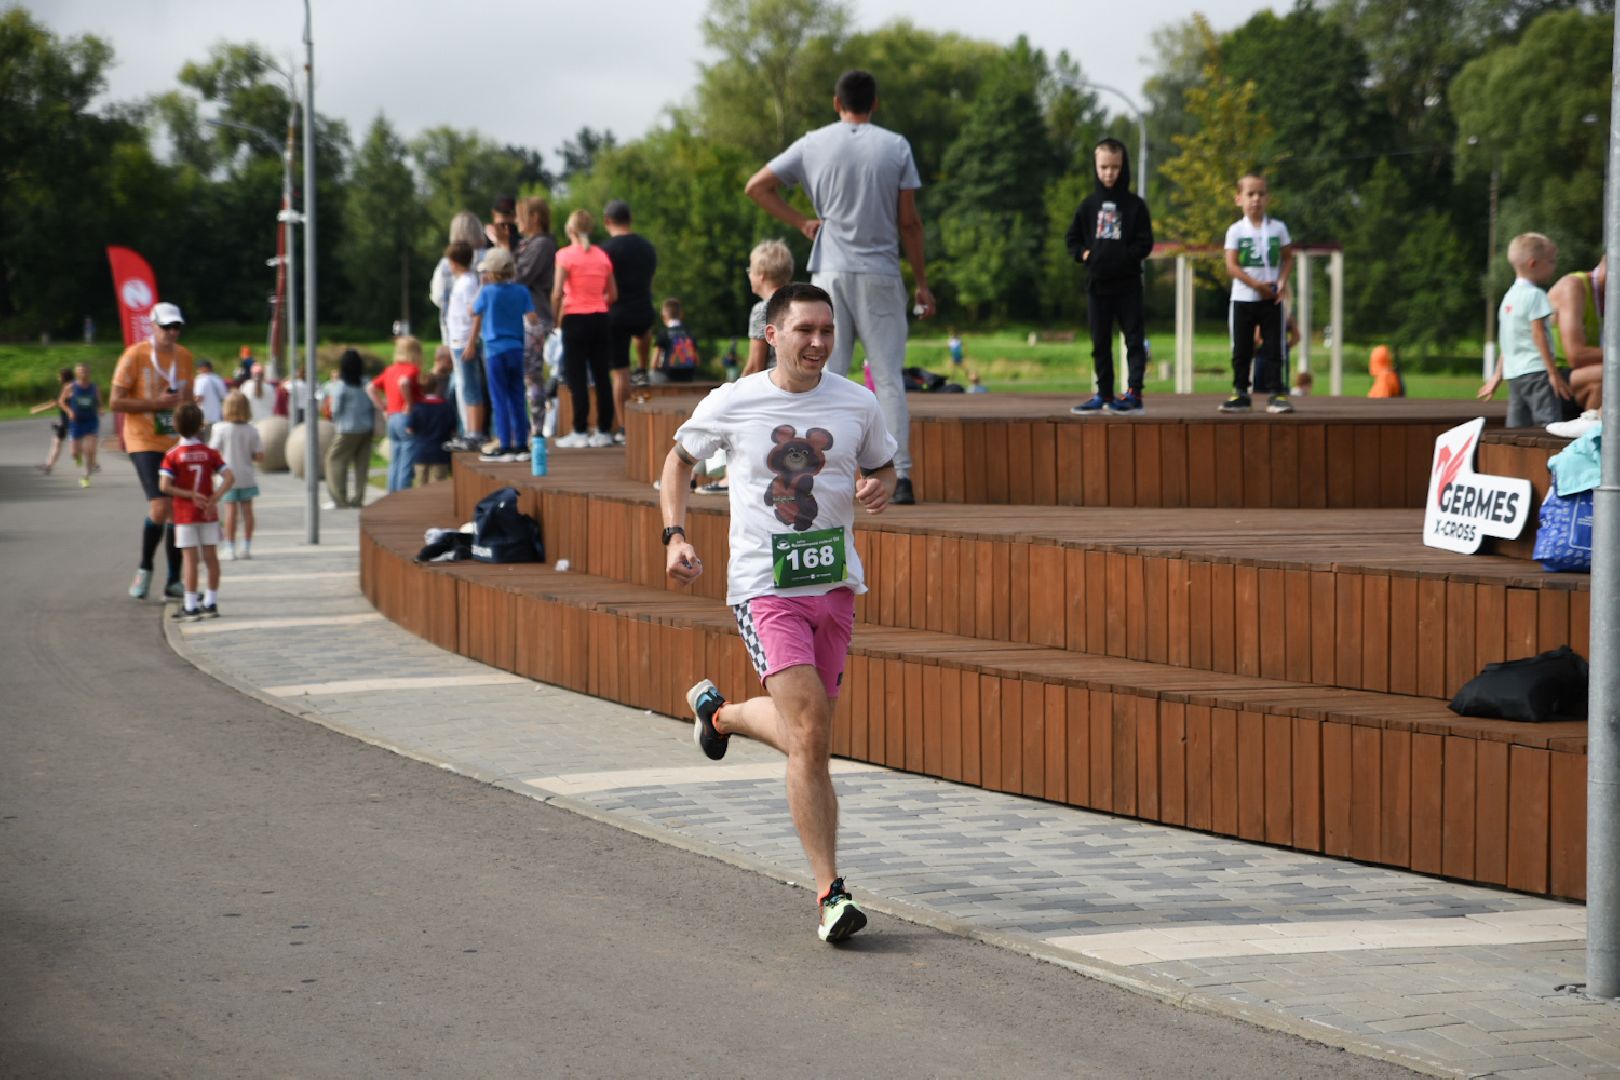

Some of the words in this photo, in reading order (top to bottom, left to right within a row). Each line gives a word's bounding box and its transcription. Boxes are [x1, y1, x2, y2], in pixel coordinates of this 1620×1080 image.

[188, 464, 203, 493] 7
[1440, 482, 1520, 524] GERMES
[1434, 519, 1477, 541] X-CROSS
[786, 545, 835, 571] 168
